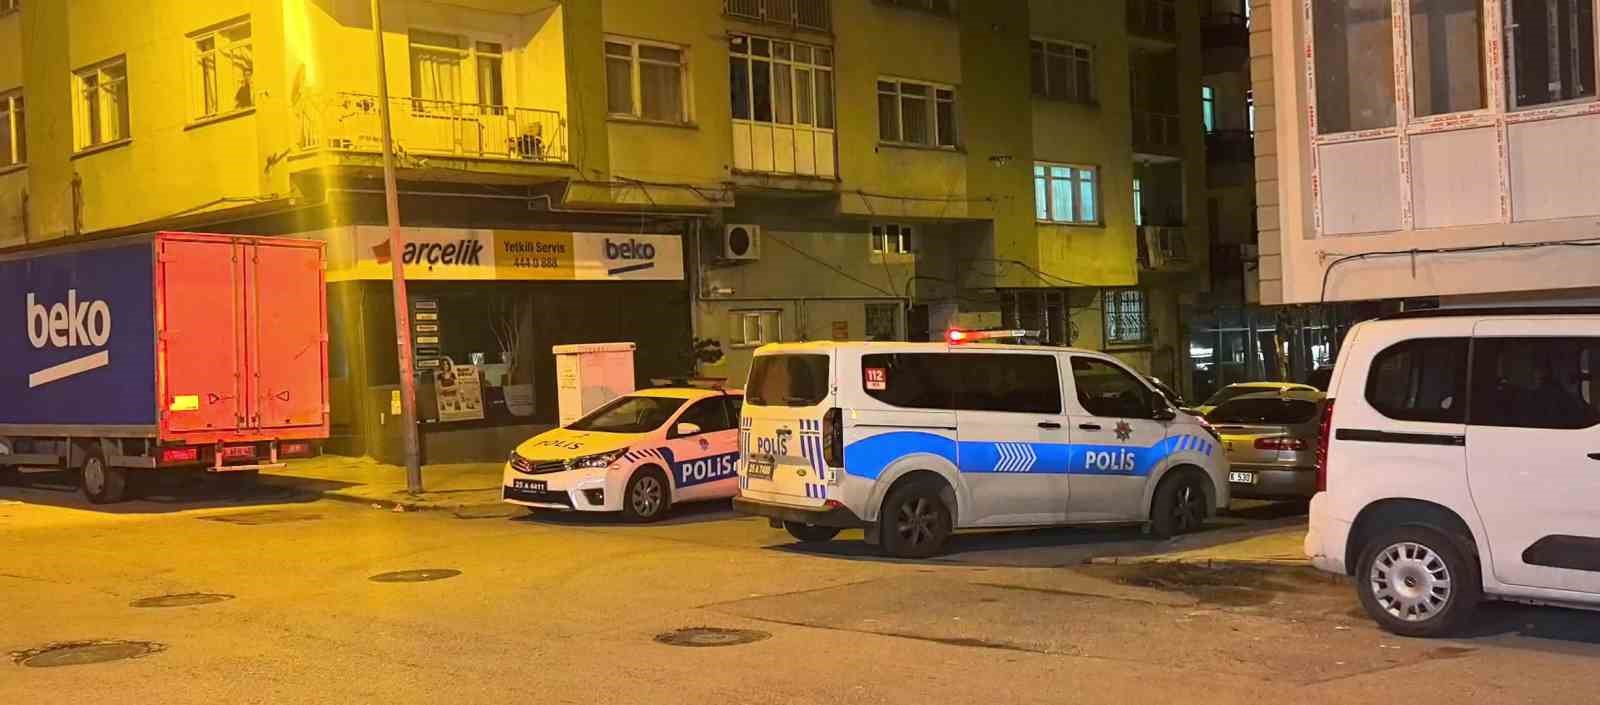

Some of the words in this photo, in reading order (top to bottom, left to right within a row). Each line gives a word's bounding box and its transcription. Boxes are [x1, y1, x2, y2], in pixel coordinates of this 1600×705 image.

[402, 239, 483, 271] arçelik
[503, 240, 534, 253] Yetkili
[536, 240, 566, 253] Servis
[604, 237, 655, 260] beko
[513, 257, 530, 268] 444
[26, 289, 111, 348] beko
[867, 369, 883, 381] 112
[1085, 447, 1136, 471] POLİS
